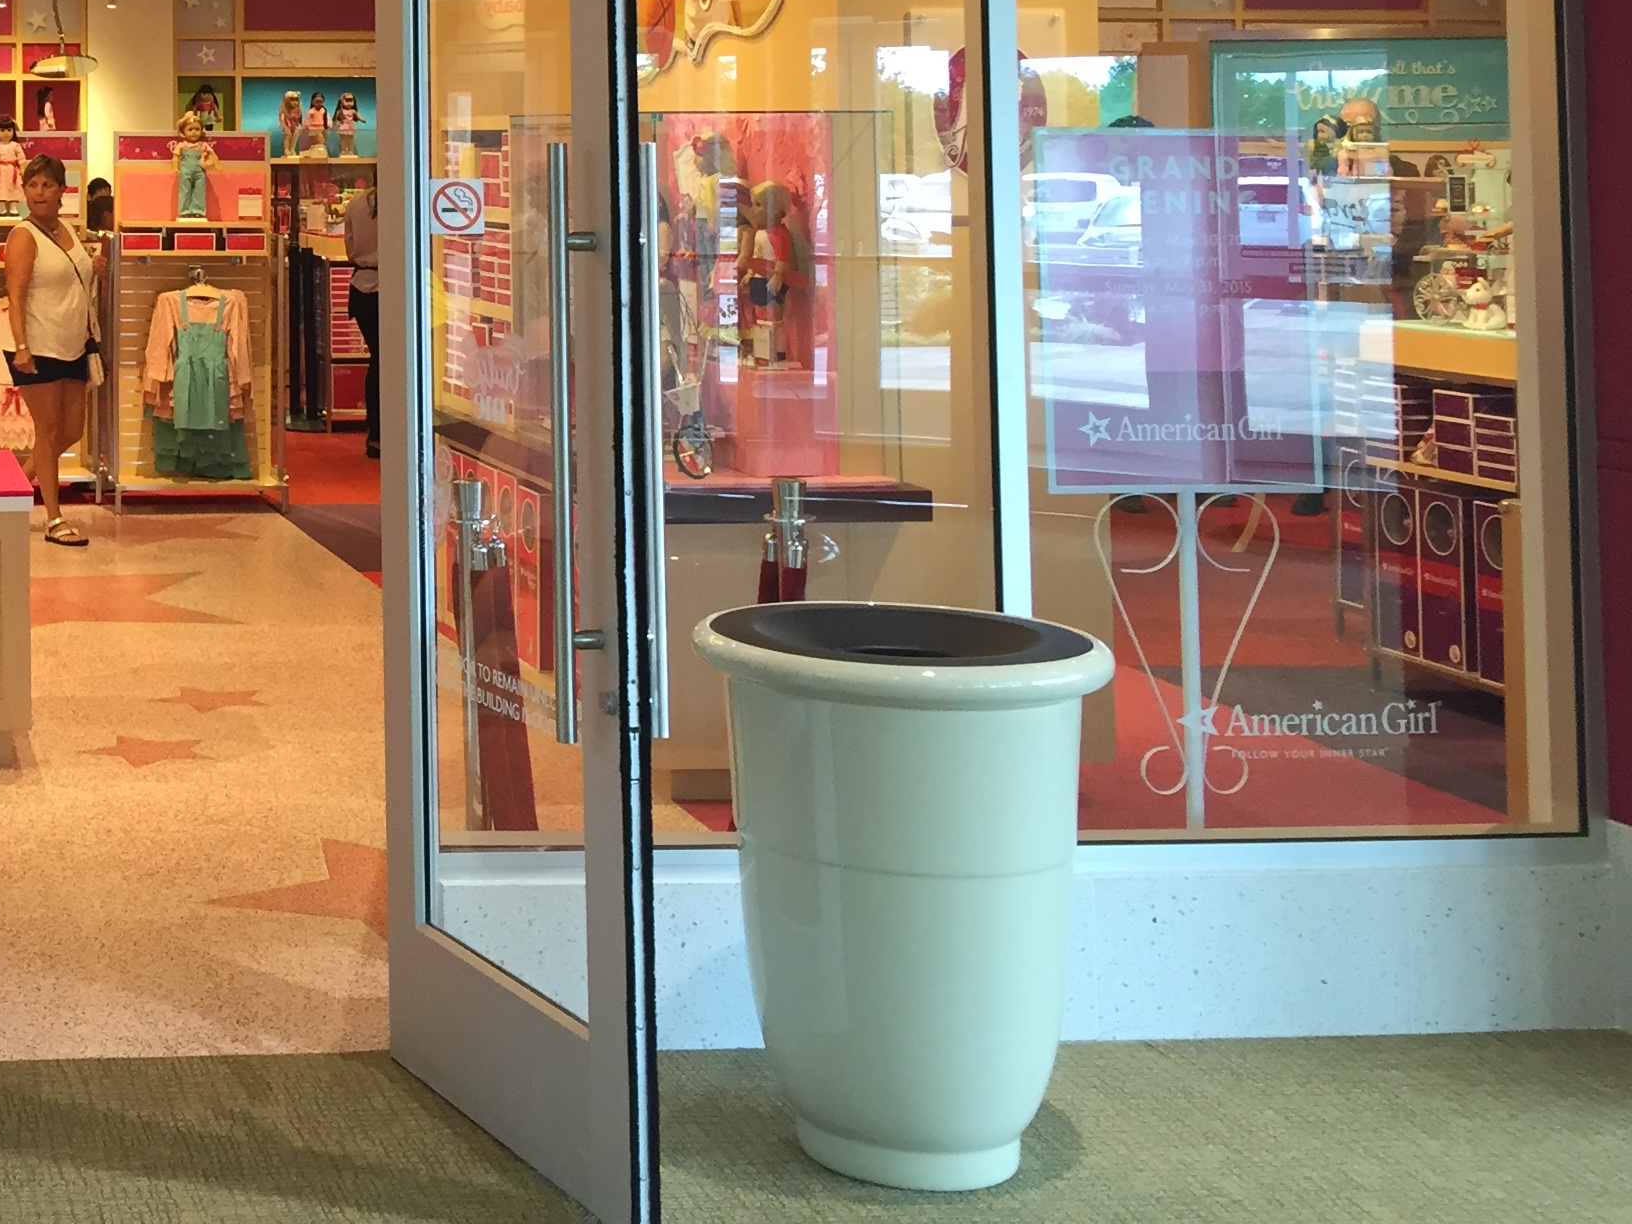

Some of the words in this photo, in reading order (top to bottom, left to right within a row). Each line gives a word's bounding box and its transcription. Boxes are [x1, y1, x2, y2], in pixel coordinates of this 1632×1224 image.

[1387, 84, 1458, 108] me
[1107, 155, 1239, 180] GRAND
[1222, 279, 1252, 294] 2015
[1115, 413, 1236, 442] American
[1237, 414, 1284, 441] Girl
[477, 662, 491, 683] TO
[476, 687, 520, 721] BUILDING
[1224, 699, 1379, 736] American
[1381, 699, 1440, 735] Girl
[1231, 749, 1279, 759] FOLLOW
[1284, 749, 1315, 759] YOUR
[1319, 748, 1354, 758] INNER
[1359, 748, 1387, 758] STAR
